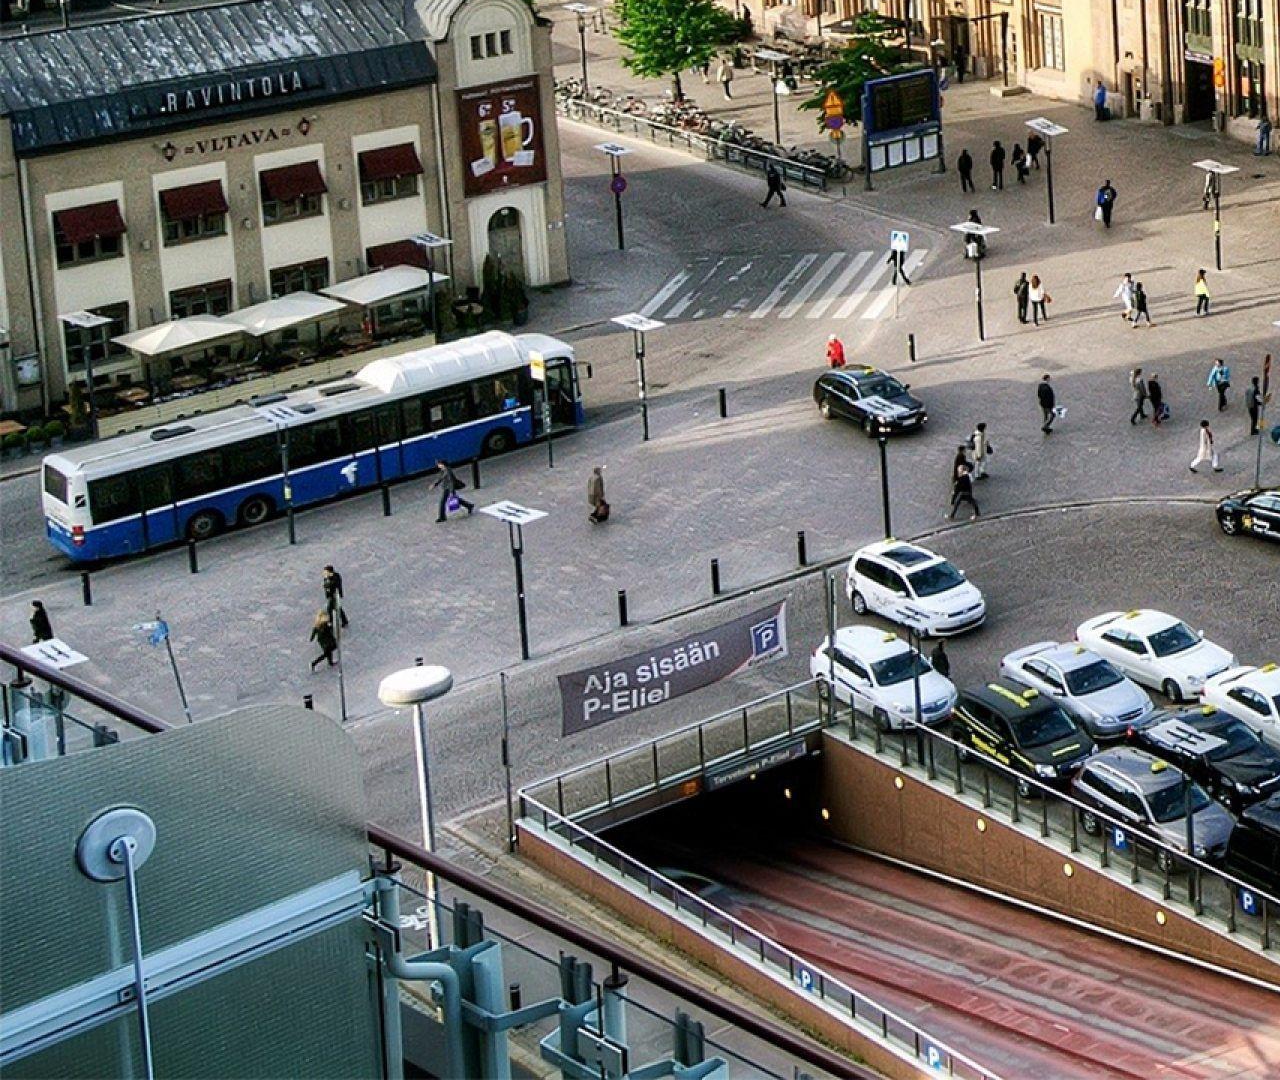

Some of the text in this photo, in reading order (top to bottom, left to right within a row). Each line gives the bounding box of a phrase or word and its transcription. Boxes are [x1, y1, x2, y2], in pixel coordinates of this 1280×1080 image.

[167, 71, 302, 113] RAVINTOLA
[196, 127, 280, 155] VLTAVA
[761, 629, 773, 649] P
[583, 671, 628, 694] Aja
[636, 640, 721, 684] sisään
[583, 681, 670, 721] P-Eliel
[1115, 829, 1126, 846] P
[1243, 892, 1254, 910] P
[801, 969, 811, 988] P
[928, 1046, 940, 1067] P
